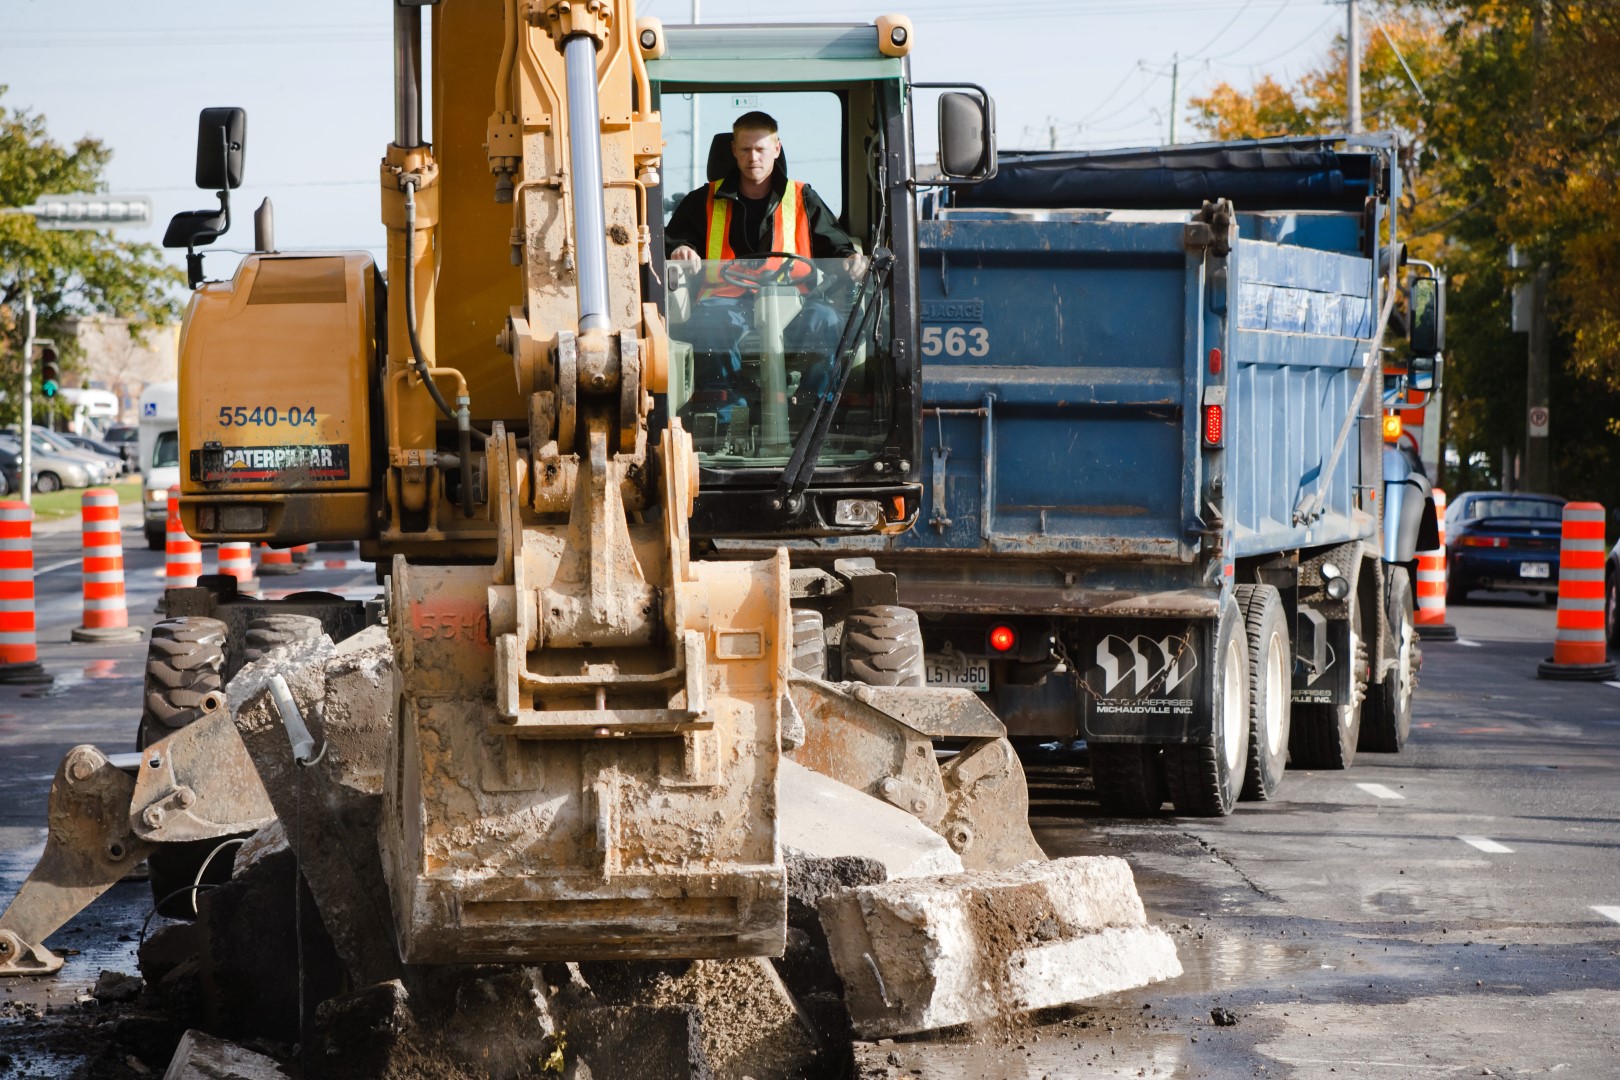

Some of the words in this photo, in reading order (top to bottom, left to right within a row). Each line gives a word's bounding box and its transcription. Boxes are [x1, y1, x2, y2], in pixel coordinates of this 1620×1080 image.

[921, 327, 990, 357] 563
[219, 406, 317, 427] 5540-04
[1096, 706, 1171, 714] MICHAUDVILLE
[1173, 706, 1193, 714] INC.
